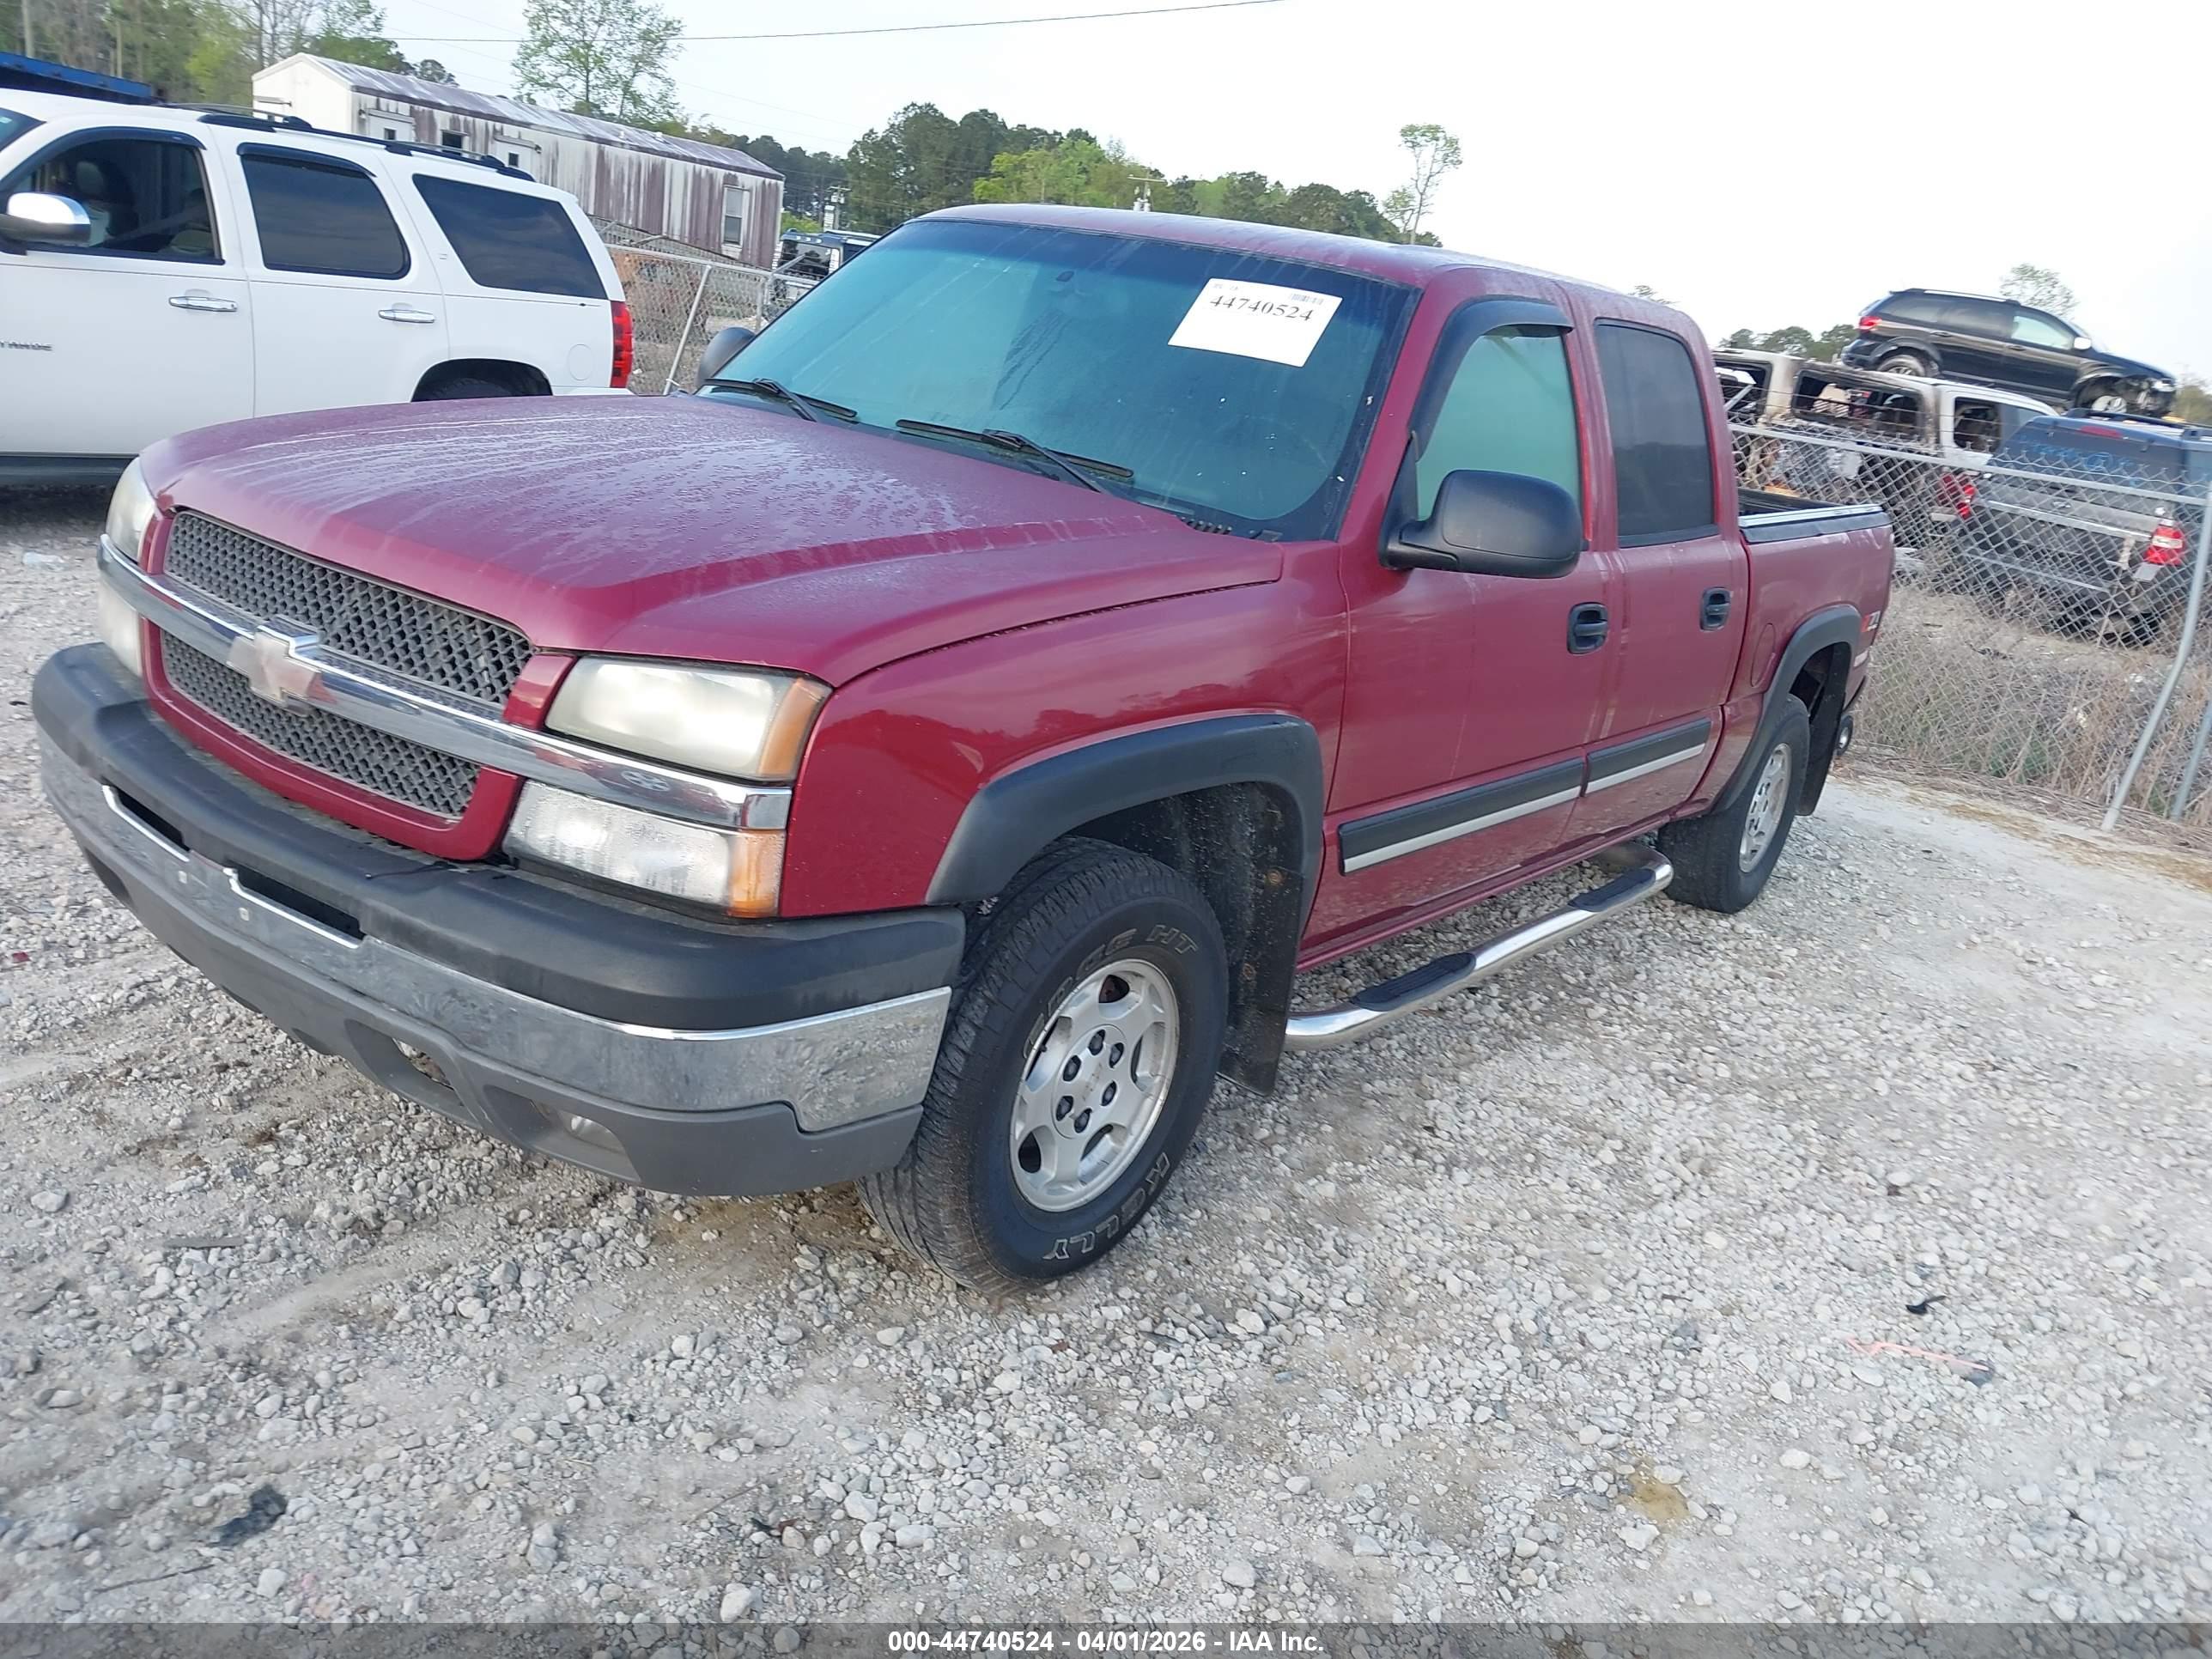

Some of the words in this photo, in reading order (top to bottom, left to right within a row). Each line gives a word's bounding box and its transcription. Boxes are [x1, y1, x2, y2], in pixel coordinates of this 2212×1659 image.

[1210, 295, 1314, 321] 44740524
[1145, 924, 1200, 955] HT
[1042, 1152, 1171, 1260] KELLY
